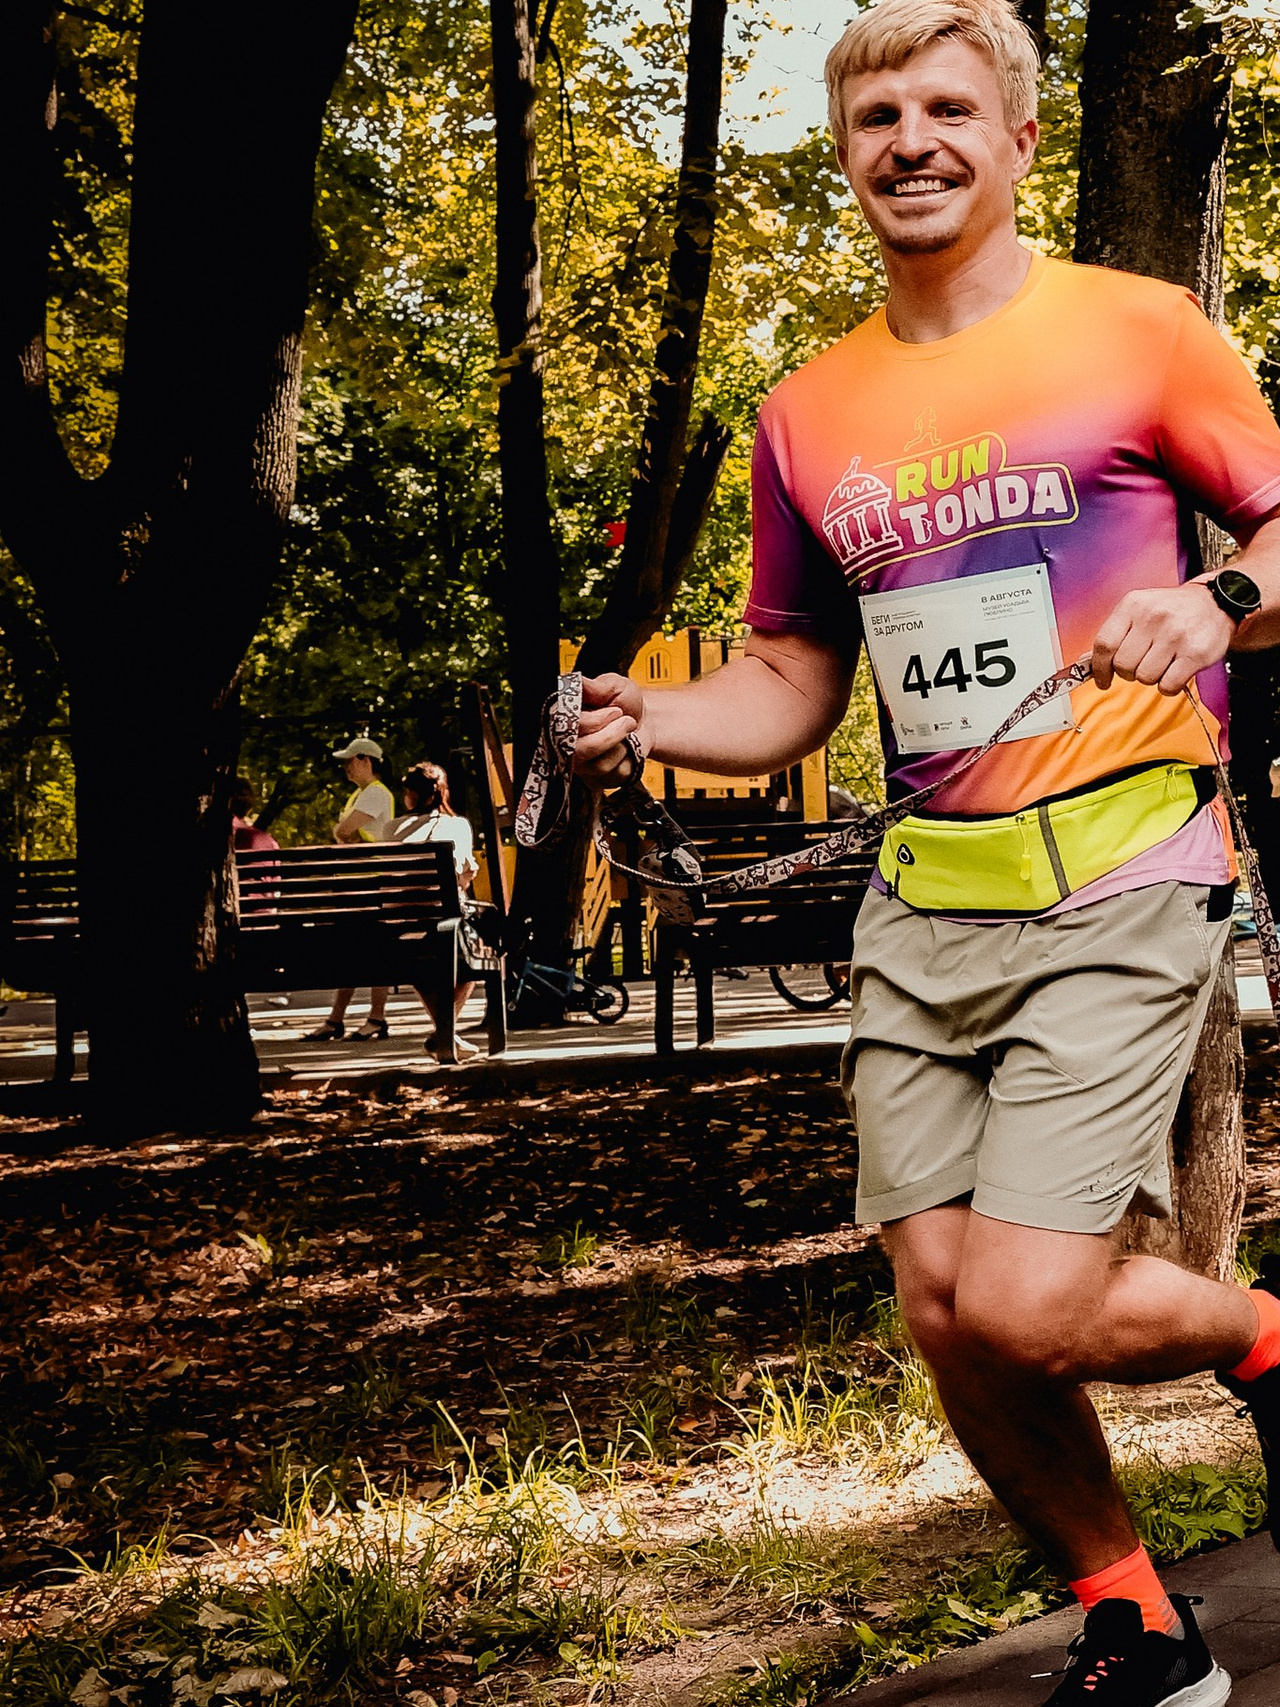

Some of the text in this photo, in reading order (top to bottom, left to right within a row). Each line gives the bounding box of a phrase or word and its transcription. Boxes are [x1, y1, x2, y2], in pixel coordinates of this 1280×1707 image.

[896, 438, 990, 502] RUN
[900, 471, 1068, 545] TONDA
[990, 589, 1032, 601] АВГУСТА
[871, 614, 891, 625] БЕГИ
[874, 620, 924, 637] ЗА ДРУГОМ
[902, 638, 1017, 699] 445
